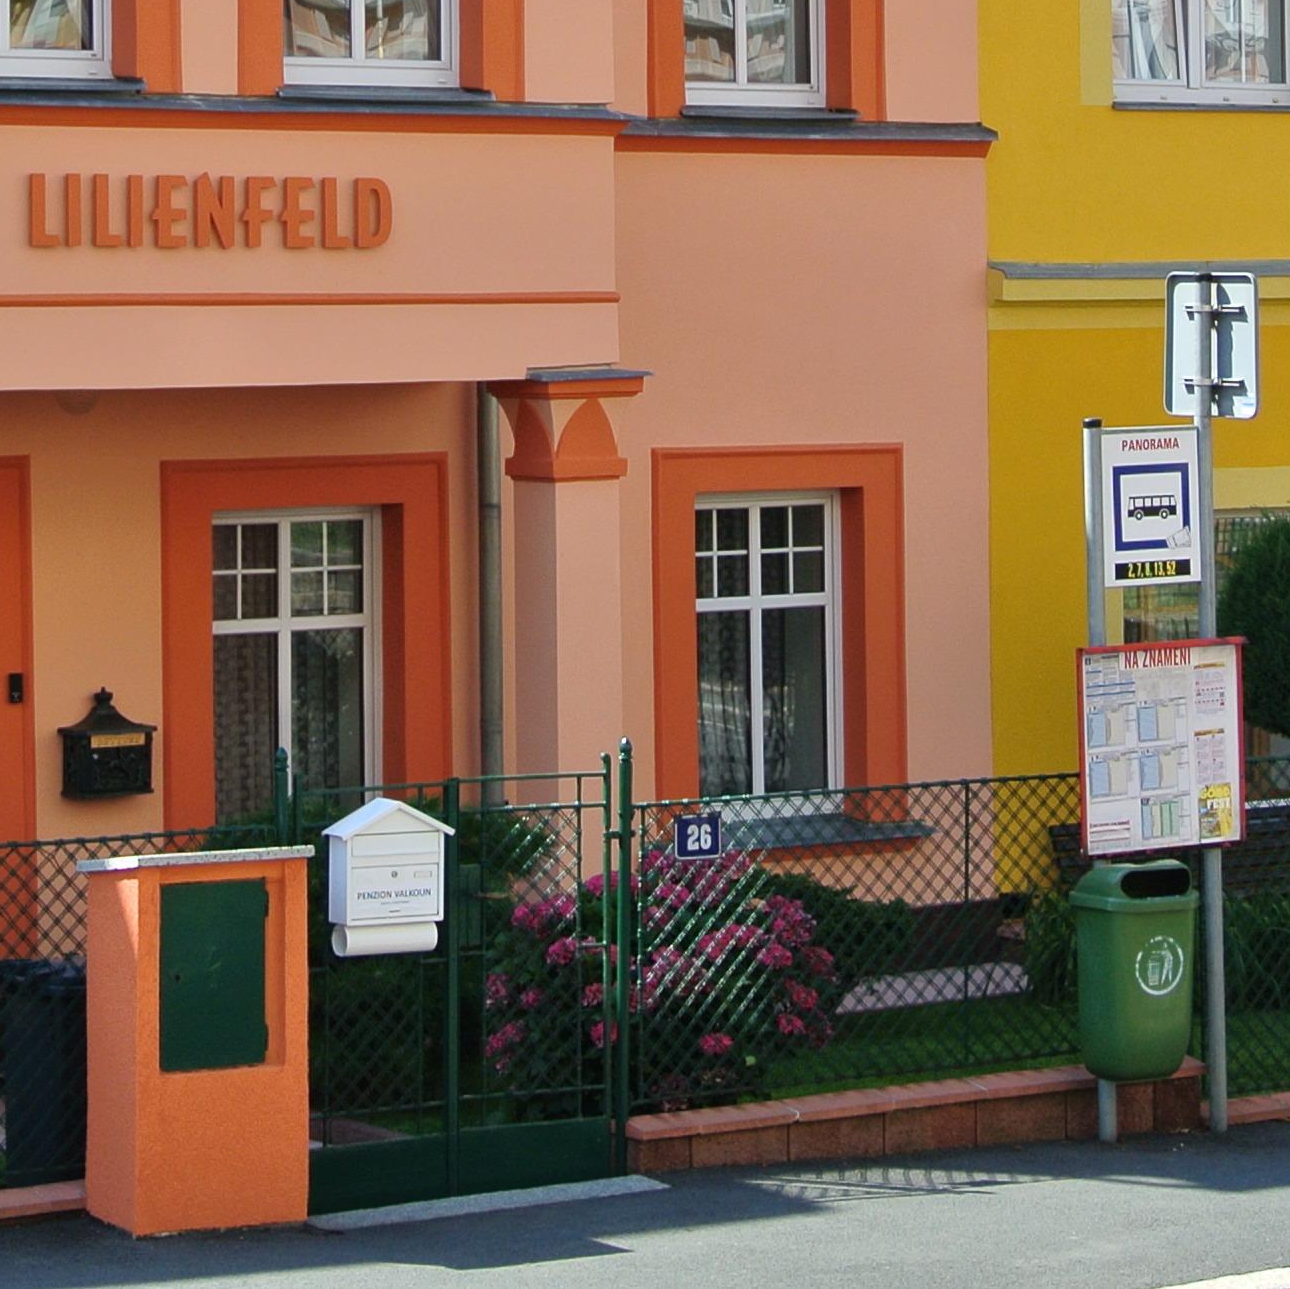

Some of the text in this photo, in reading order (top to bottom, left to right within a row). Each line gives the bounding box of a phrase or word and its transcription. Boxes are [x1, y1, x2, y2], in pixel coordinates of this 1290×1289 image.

[28, 171, 393, 250] LILIENFELD
[1121, 437, 1180, 452] PANORAMA
[1125, 650, 1139, 669] NA
[687, 823, 712, 851] 26
[357, 890, 392, 900] PENZION
